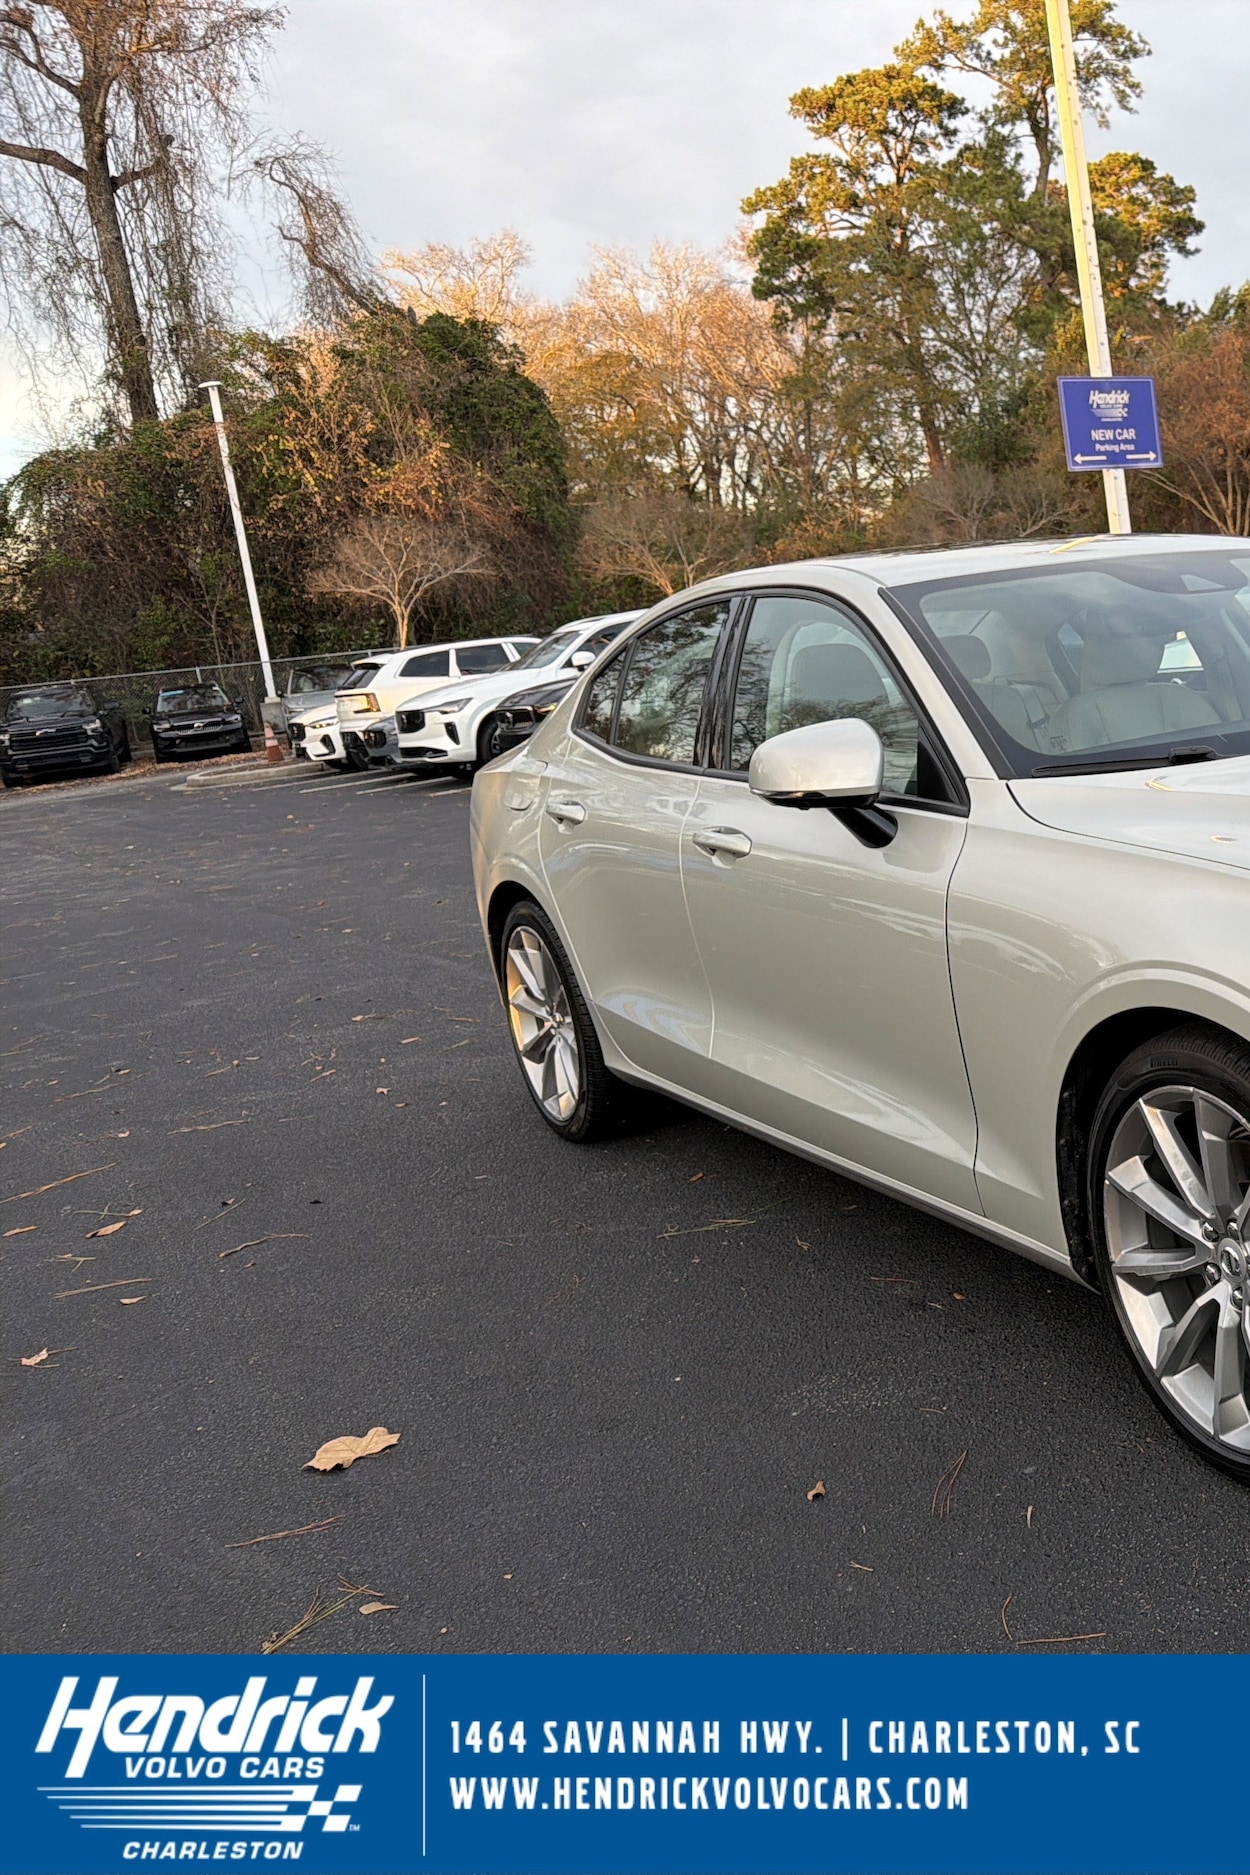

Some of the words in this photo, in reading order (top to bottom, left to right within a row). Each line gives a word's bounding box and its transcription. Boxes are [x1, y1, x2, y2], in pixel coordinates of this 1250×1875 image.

[1088, 389, 1130, 409] Hendrick
[1091, 429, 1114, 441] NEW
[1115, 428, 1136, 440] CAR
[1095, 443, 1120, 453] Parking
[1120, 443, 1135, 451] Area
